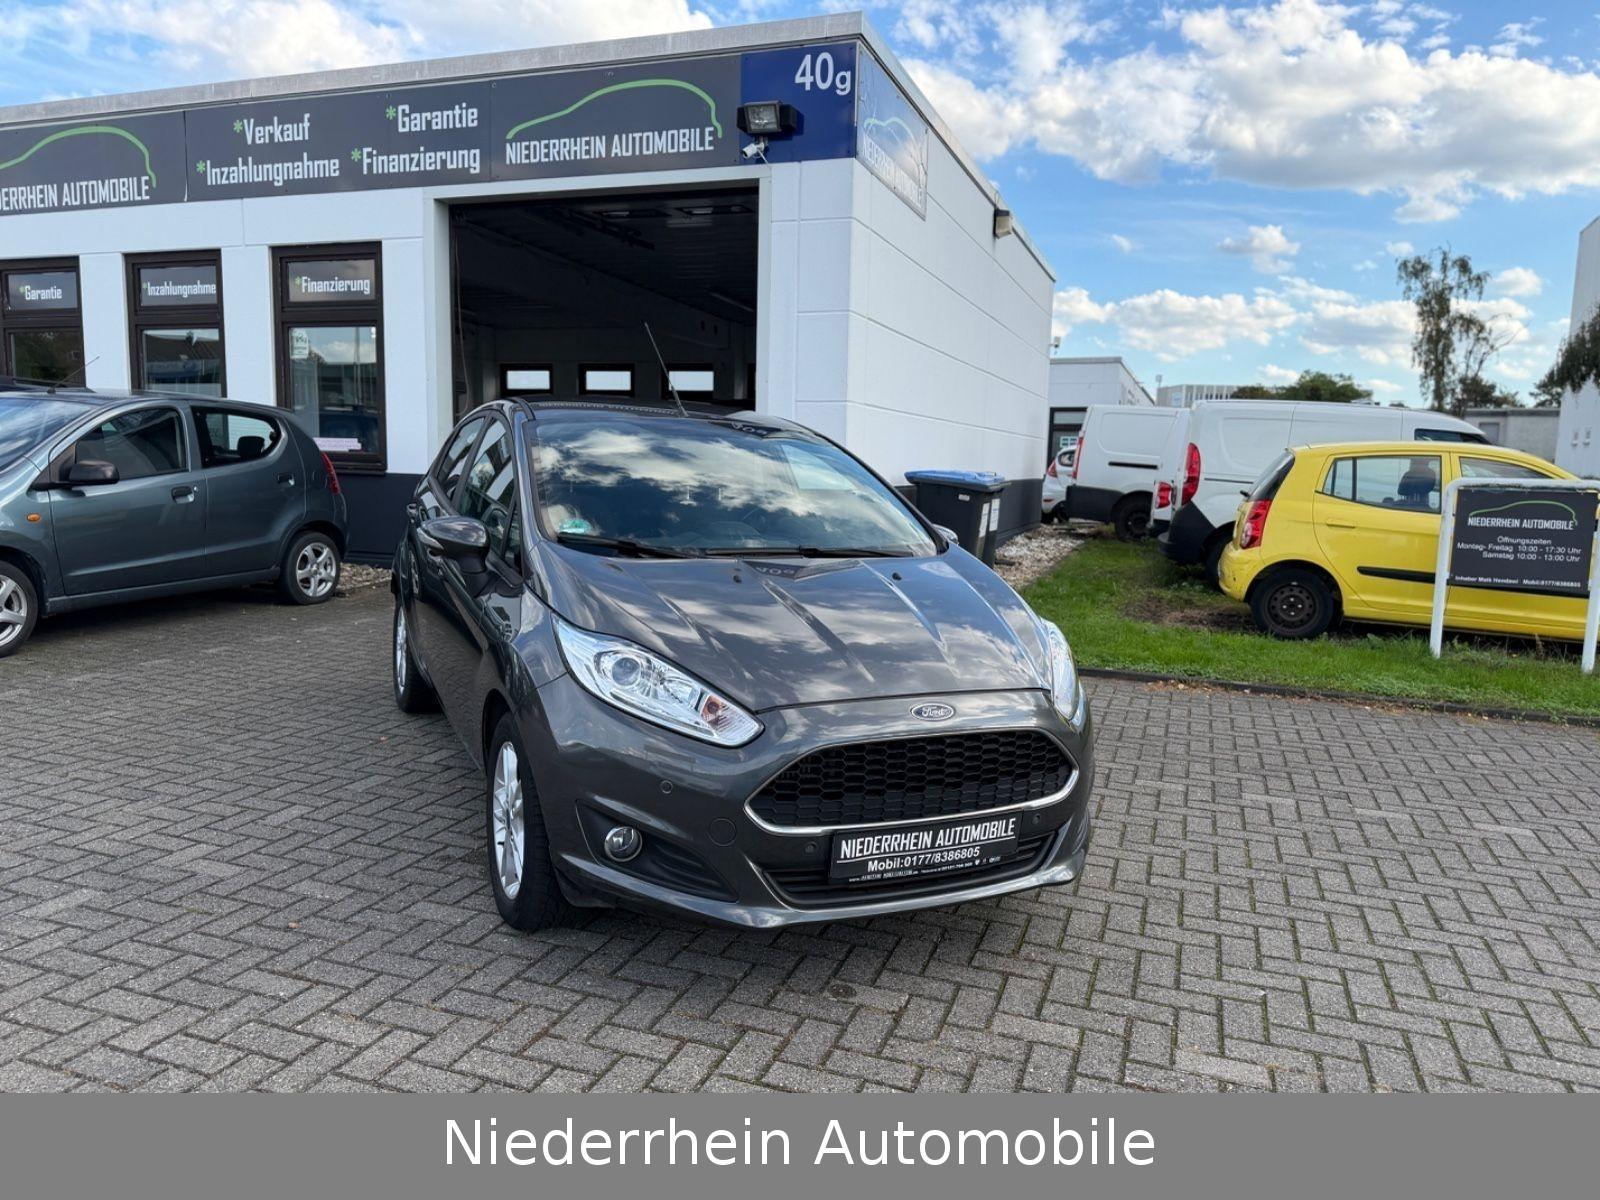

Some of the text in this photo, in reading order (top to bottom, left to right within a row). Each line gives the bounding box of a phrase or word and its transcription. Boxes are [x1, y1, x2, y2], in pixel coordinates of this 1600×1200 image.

[794, 52, 852, 96] 40g
[505, 127, 714, 165] NIEDERRHEIN AUTOMOBILE
[62, 176, 150, 206] AUTOMOBILE
[1468, 517, 1574, 530] NIEDERRHEIN AUTOMOBILE
[1482, 551, 1514, 560] Samstag
[1517, 552, 1537, 560] 10:00
[1567, 547, 1581, 555] Uhr
[840, 817, 1016, 860] NIEDERRHEIN AUTOMOBILE
